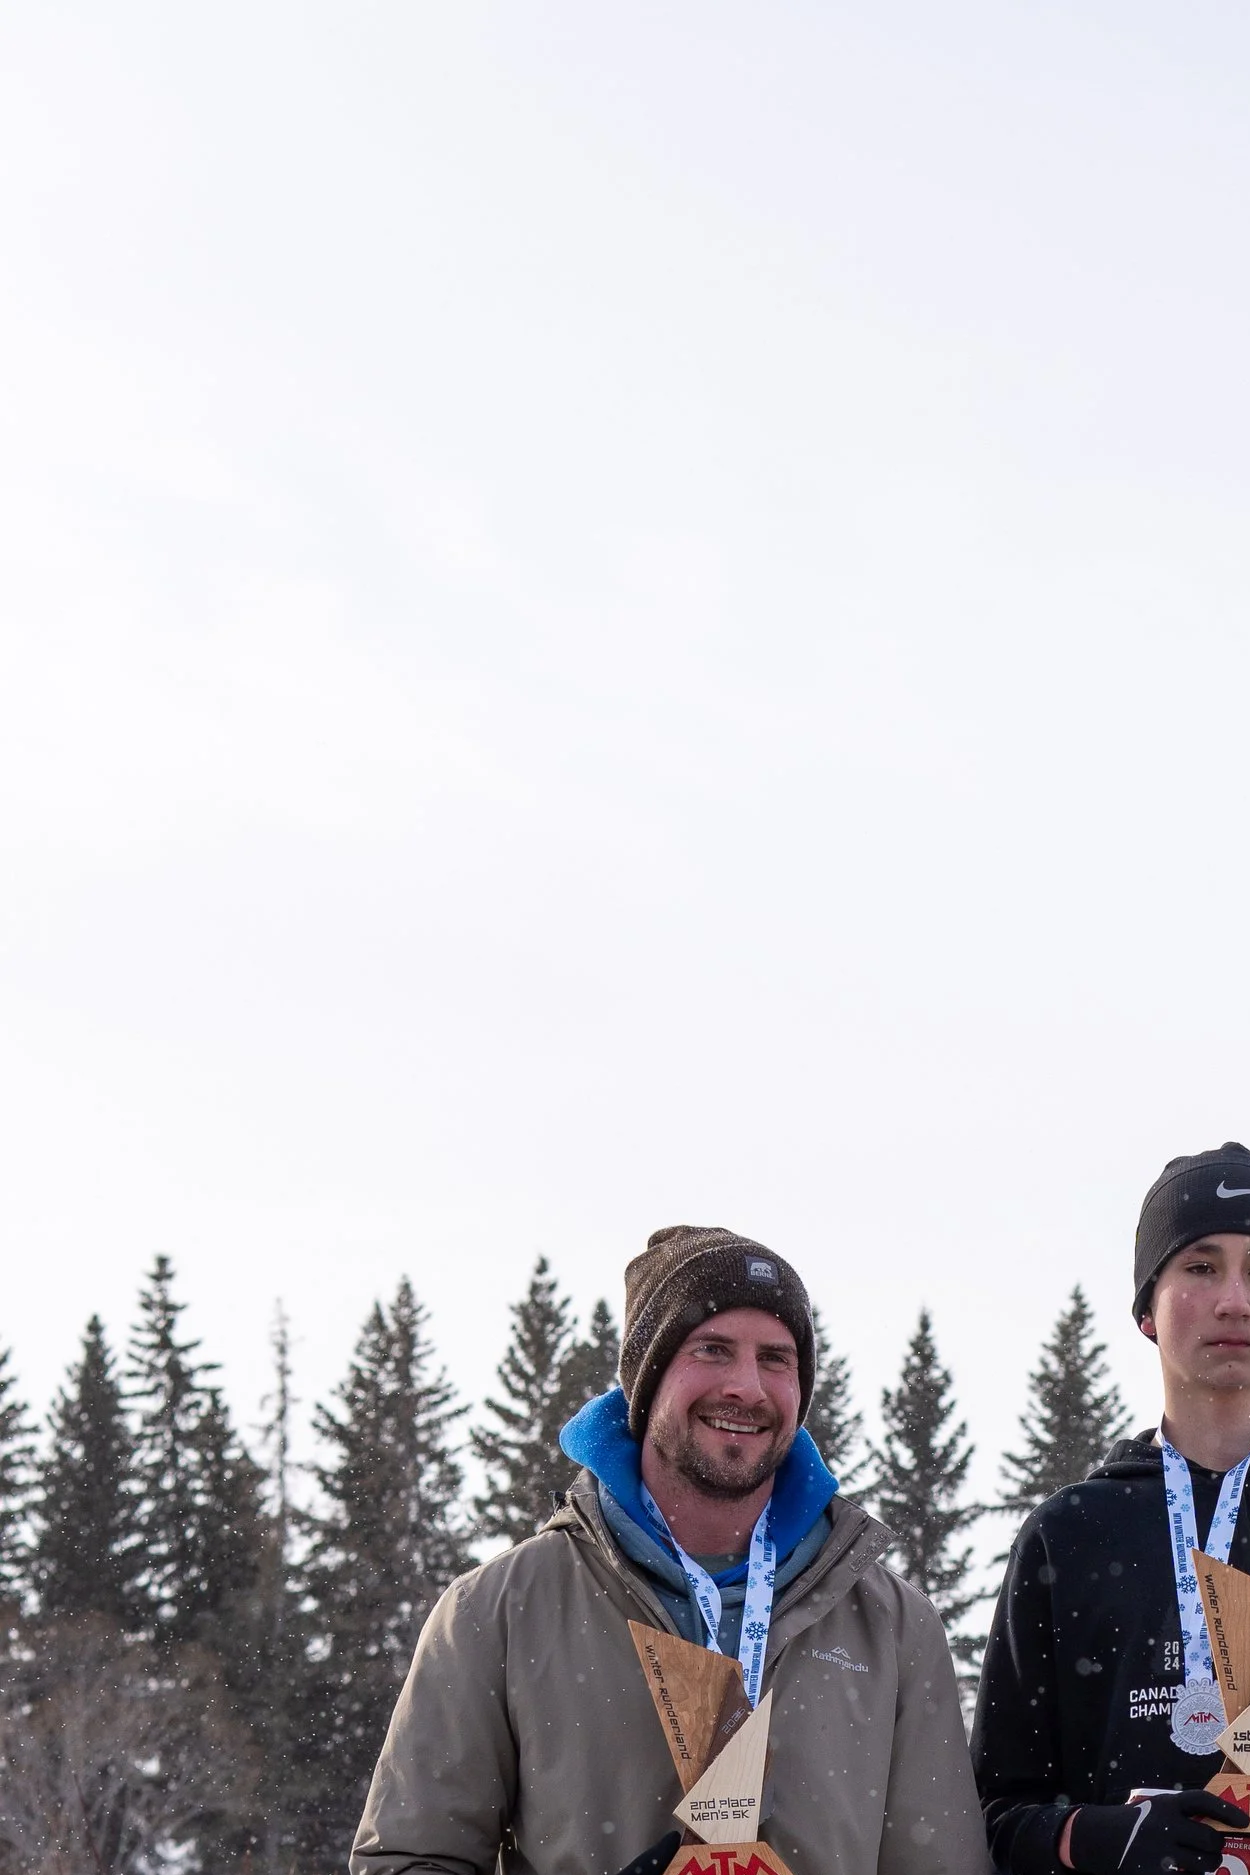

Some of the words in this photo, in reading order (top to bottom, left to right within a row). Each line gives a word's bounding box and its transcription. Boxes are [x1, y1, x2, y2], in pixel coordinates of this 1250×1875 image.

[1173, 1513, 1182, 1525] MTM
[1175, 1525, 1184, 1543] WINTER
[1164, 1641, 1180, 1655] 20
[811, 1648, 869, 1673] Kathmandu
[1164, 1657, 1180, 1670] 24
[1129, 1686, 1178, 1703] CANAD
[1130, 1702, 1175, 1719] CHAM
[1184, 1712, 1220, 1726] MTM
[1233, 1730, 1250, 1741] 1st
[690, 1798, 716, 1810] 2nd
[720, 1797, 756, 1809] Place
[691, 1810, 729, 1822] Men's
[733, 1809, 749, 1819] 5K
